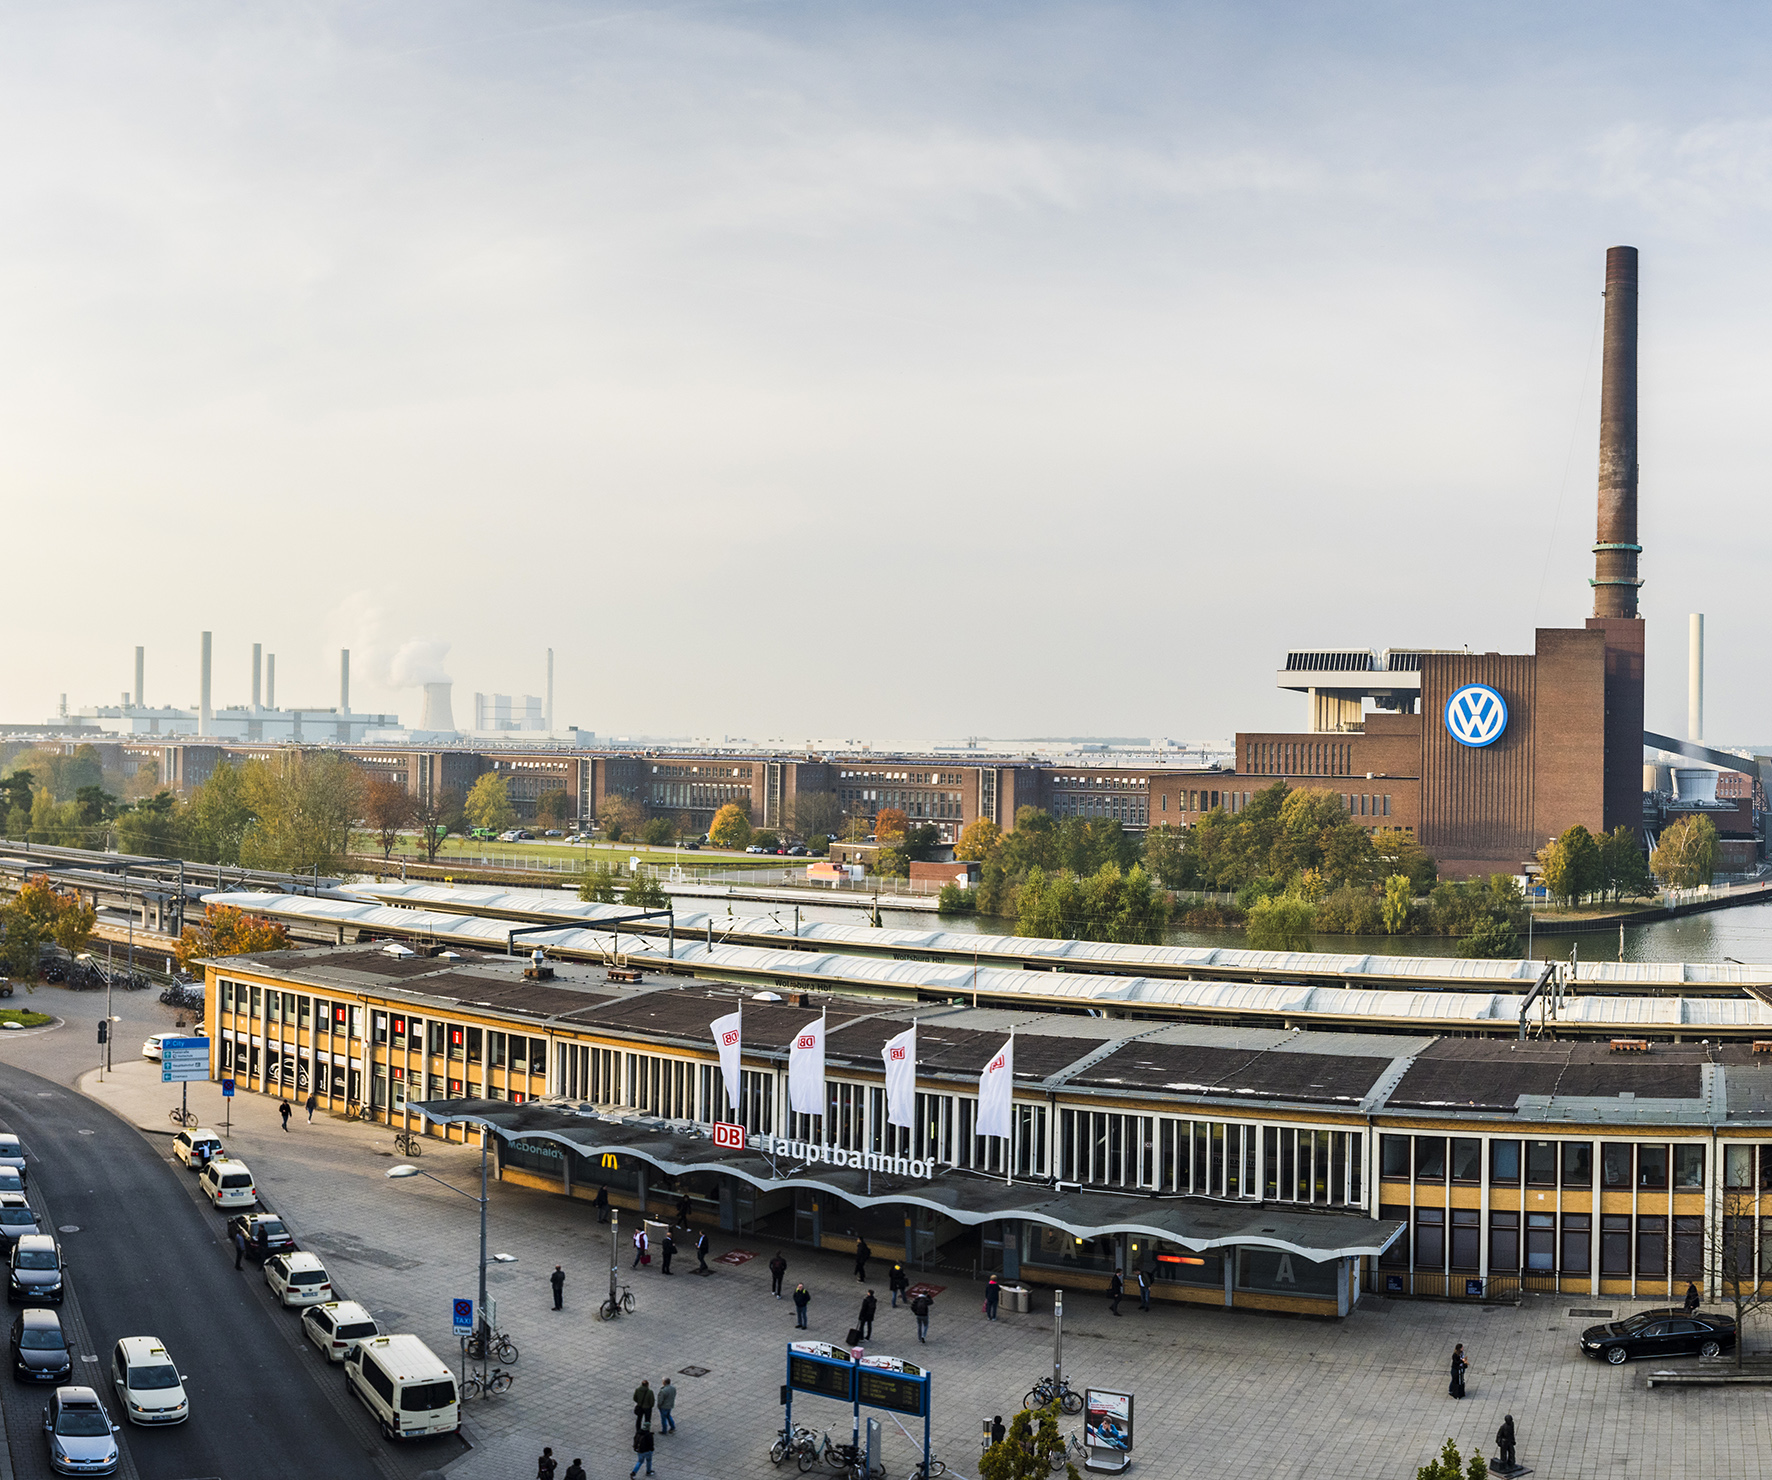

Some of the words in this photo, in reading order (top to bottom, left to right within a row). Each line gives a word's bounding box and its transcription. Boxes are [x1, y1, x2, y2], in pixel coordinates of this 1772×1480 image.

[1448, 687, 1504, 743] VW
[932, 956, 945, 964] Hbf
[818, 983, 832, 992] Hbf
[717, 1126, 741, 1146] DB
[507, 1140, 564, 1160] McDonald's
[1059, 1231, 1078, 1260] A
[1275, 1253, 1296, 1283] A
[455, 1316, 472, 1324] TAXI
